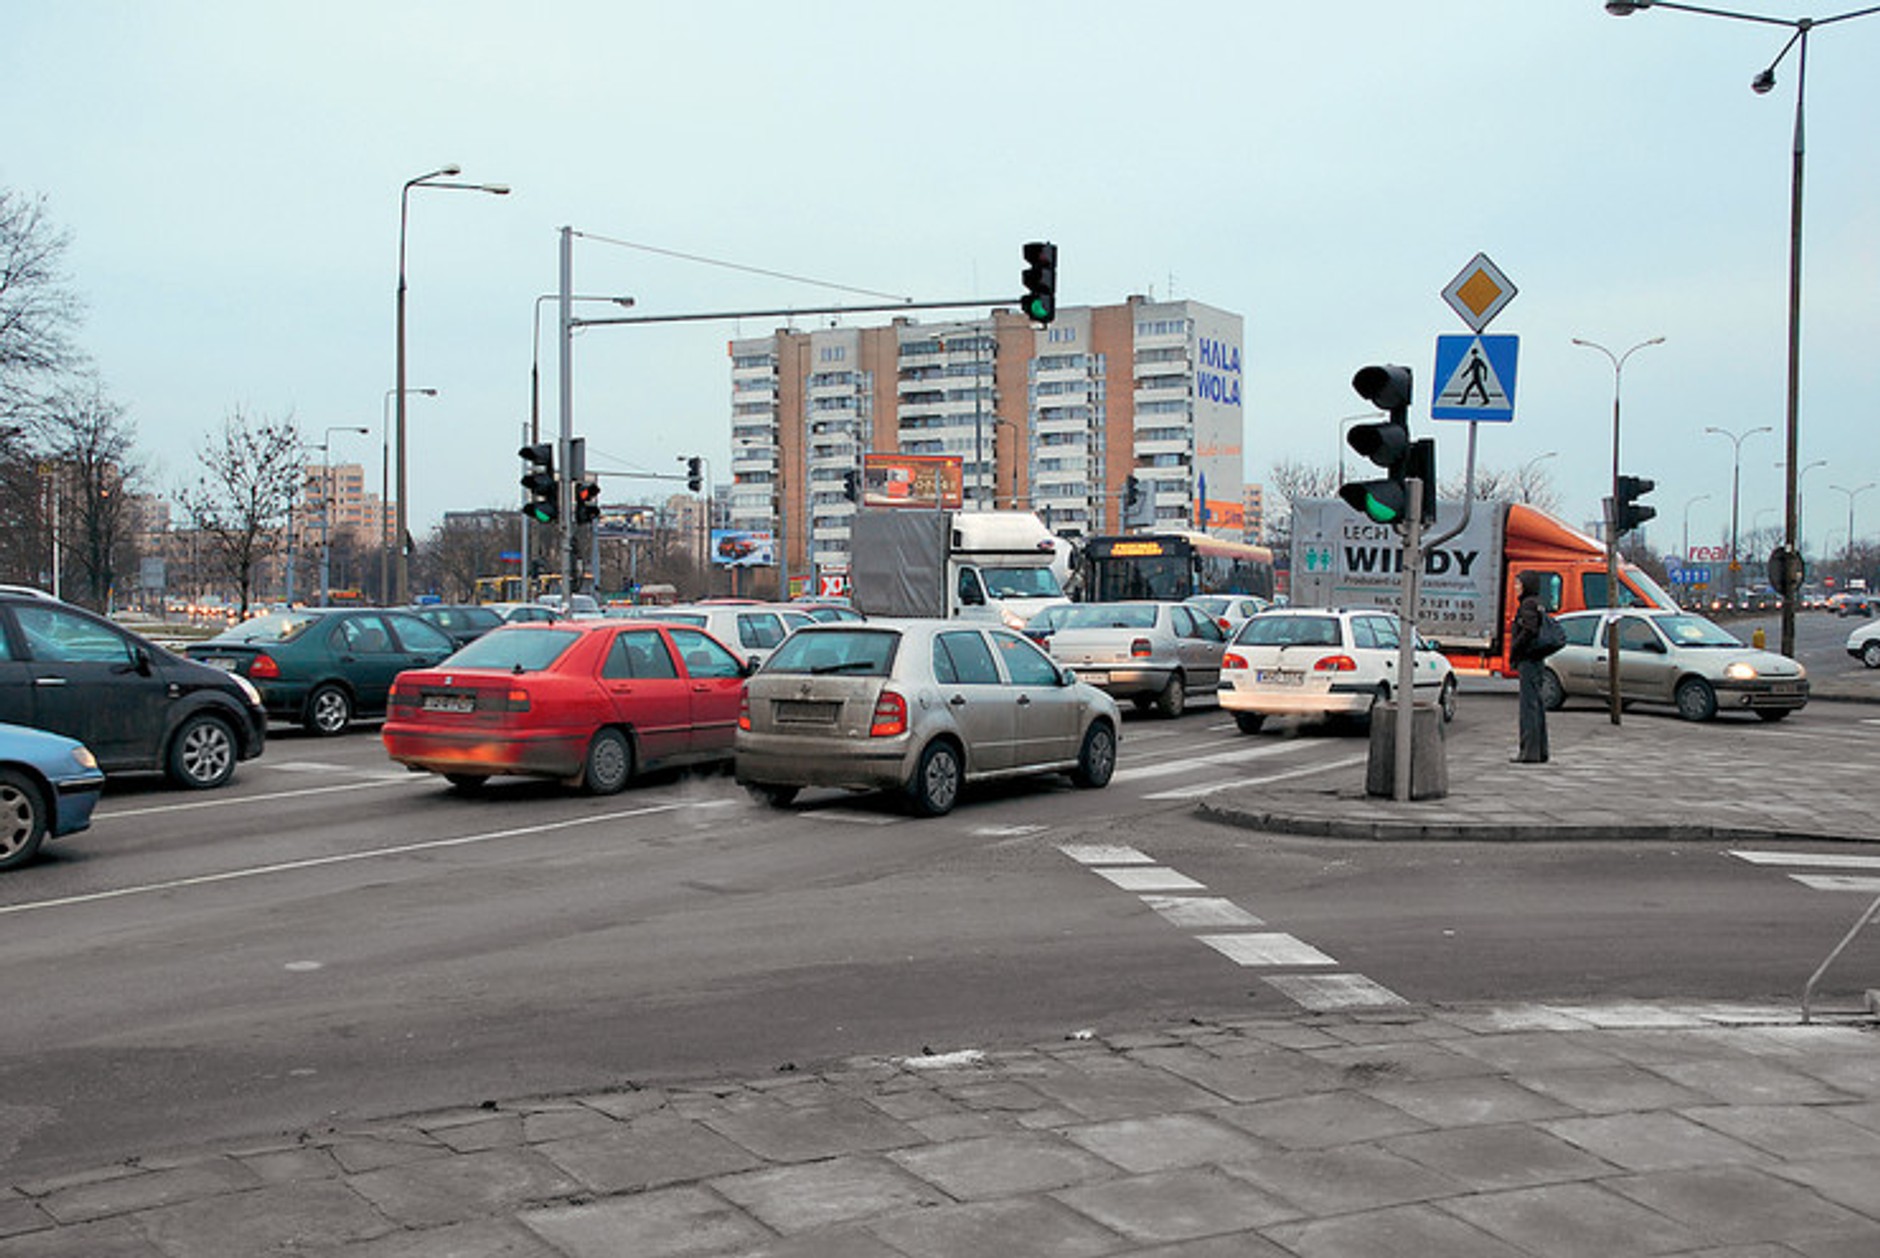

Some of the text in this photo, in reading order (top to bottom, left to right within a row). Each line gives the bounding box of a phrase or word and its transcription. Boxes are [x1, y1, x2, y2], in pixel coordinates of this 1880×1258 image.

[1199, 337, 1241, 374] HALA
[1197, 370, 1241, 407] WOLA
[1344, 526, 1388, 540] LECH
